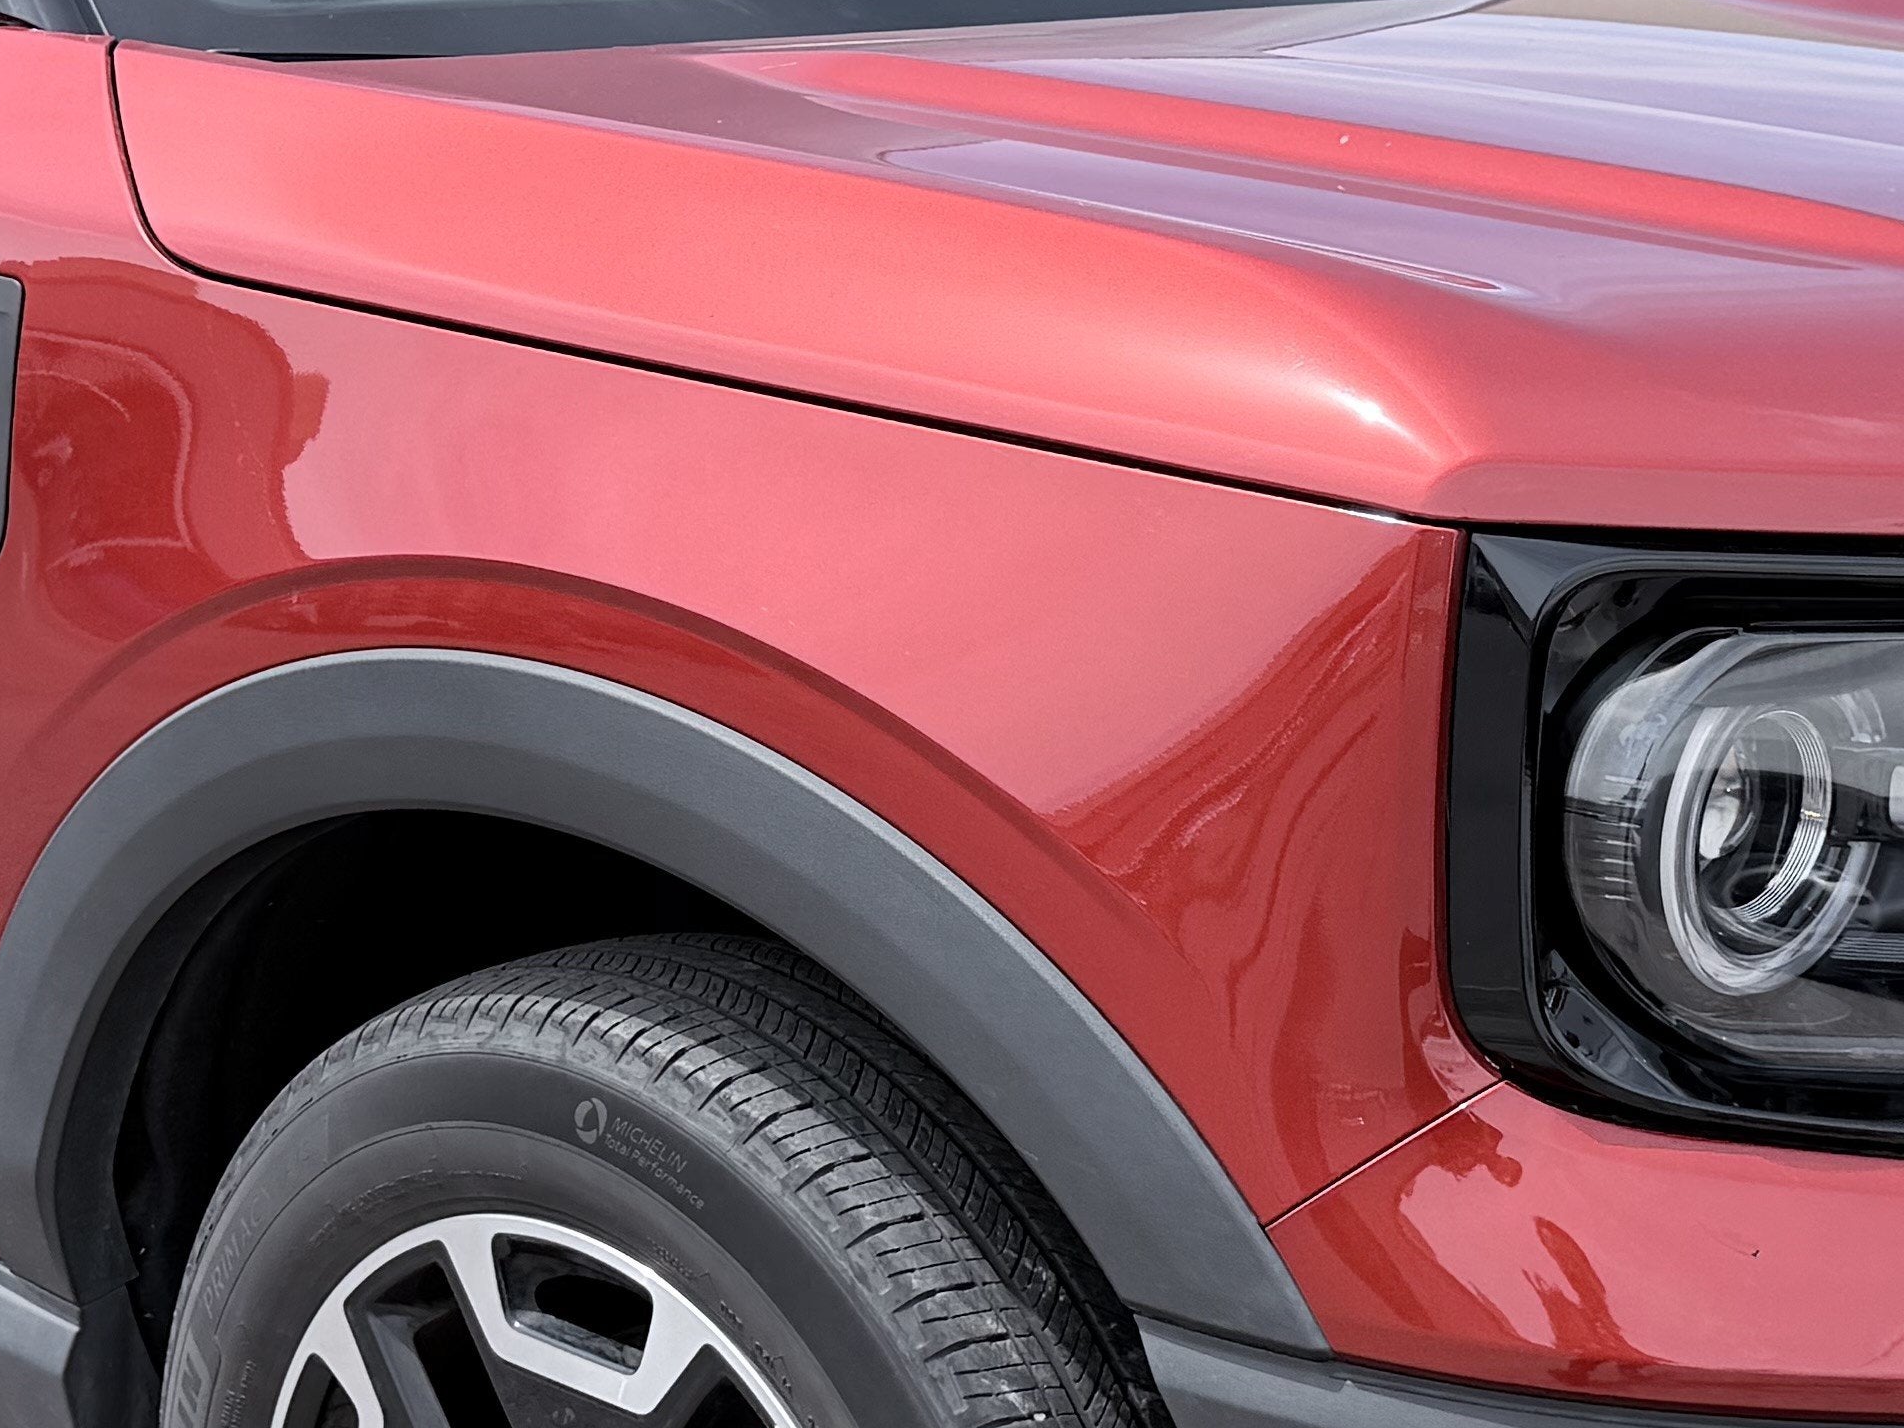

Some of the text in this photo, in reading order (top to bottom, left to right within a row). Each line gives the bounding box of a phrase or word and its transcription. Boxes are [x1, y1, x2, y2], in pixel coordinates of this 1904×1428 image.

[604, 1132, 705, 1210] Total Performance
[610, 1117, 688, 1173] MICHELIN
